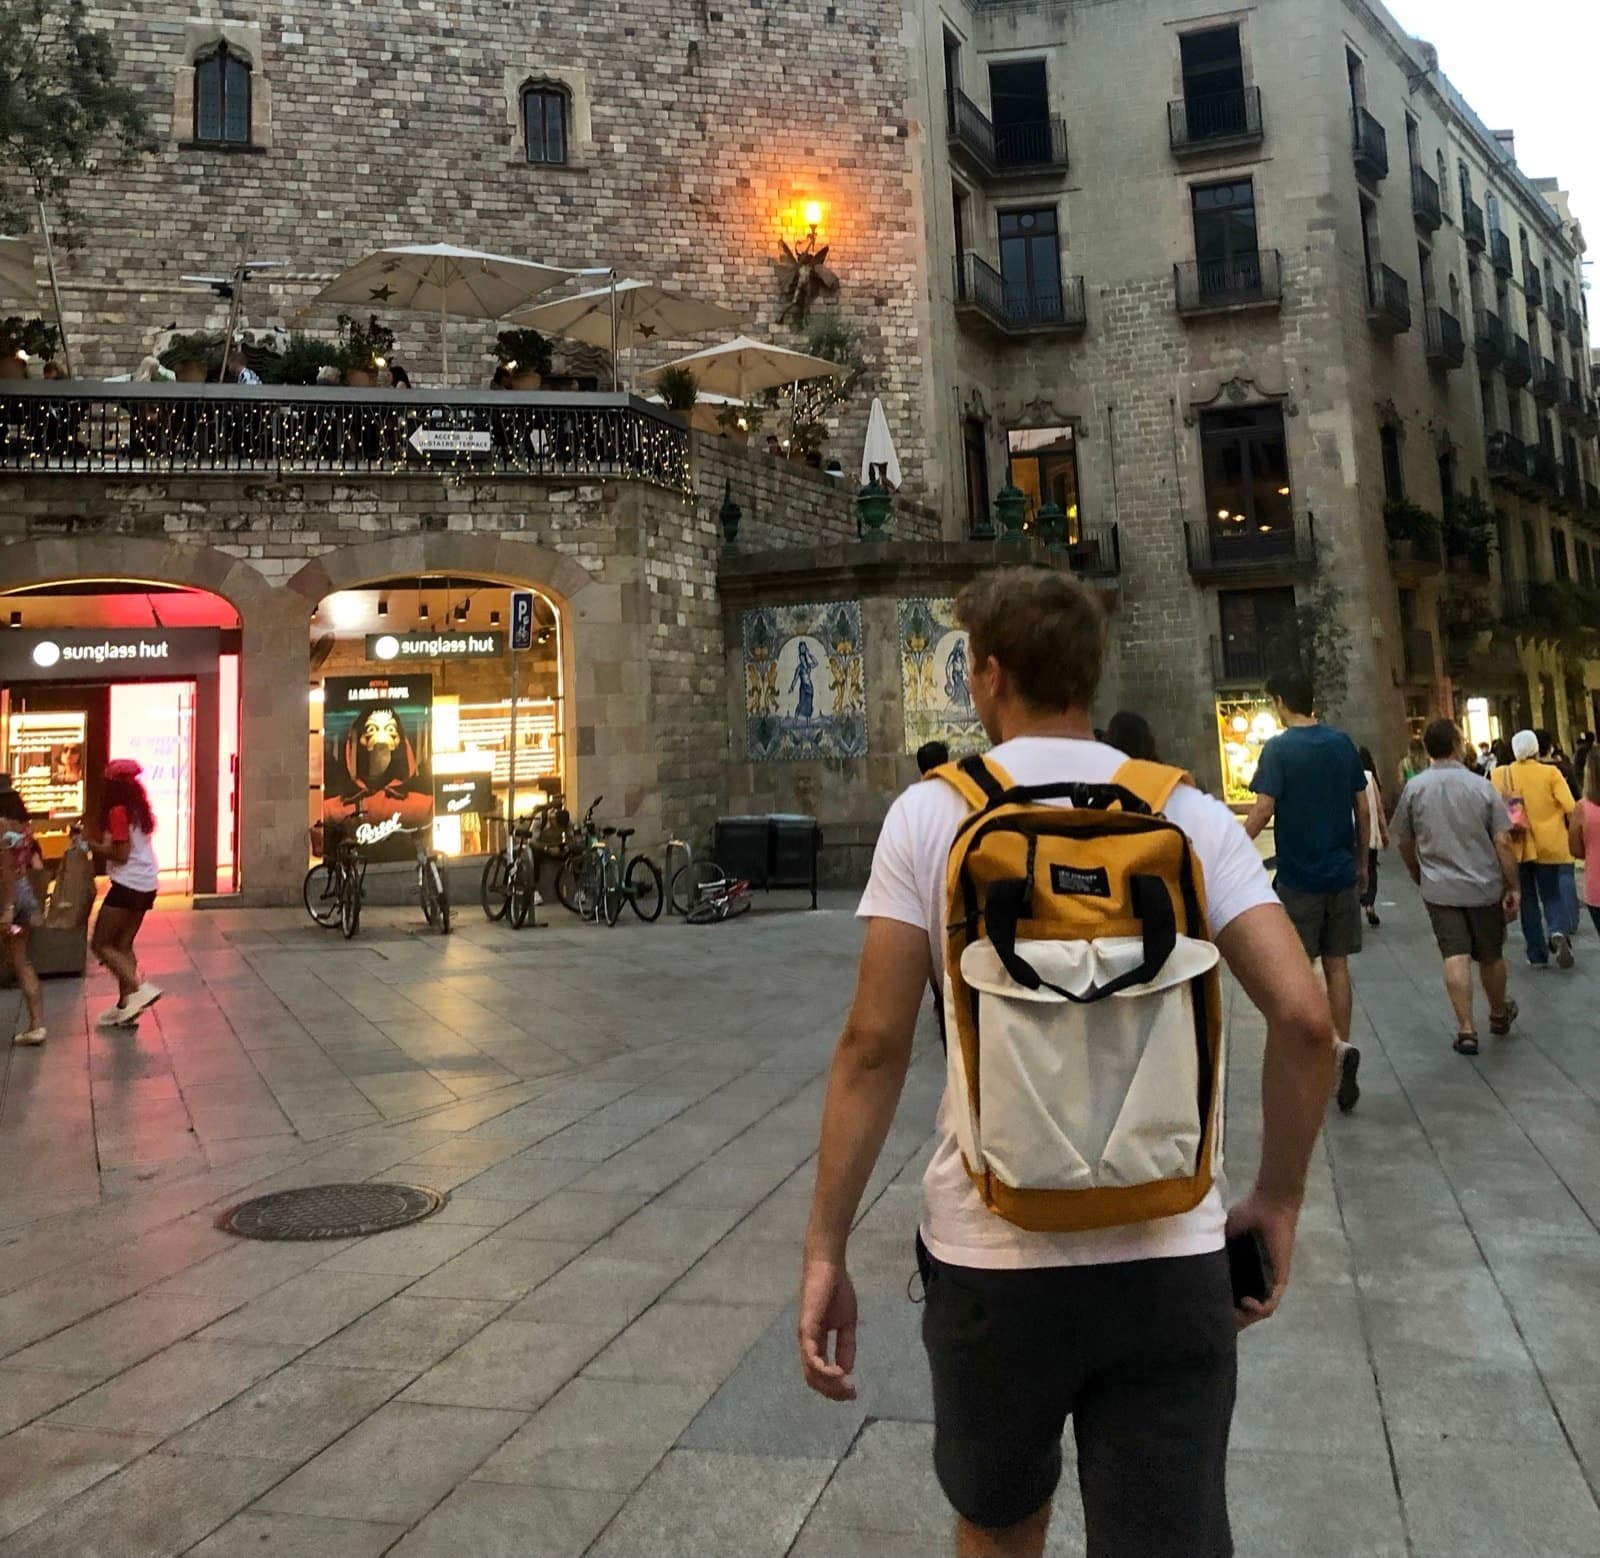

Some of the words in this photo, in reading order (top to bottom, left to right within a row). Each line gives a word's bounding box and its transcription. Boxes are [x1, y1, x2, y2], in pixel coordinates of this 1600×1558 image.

[518, 600, 528, 622] P
[62, 641, 138, 663] sunglass
[140, 640, 169, 658] hut
[401, 635, 467, 657] sunglass
[468, 635, 494, 652] hut
[355, 811, 402, 844] Persol
